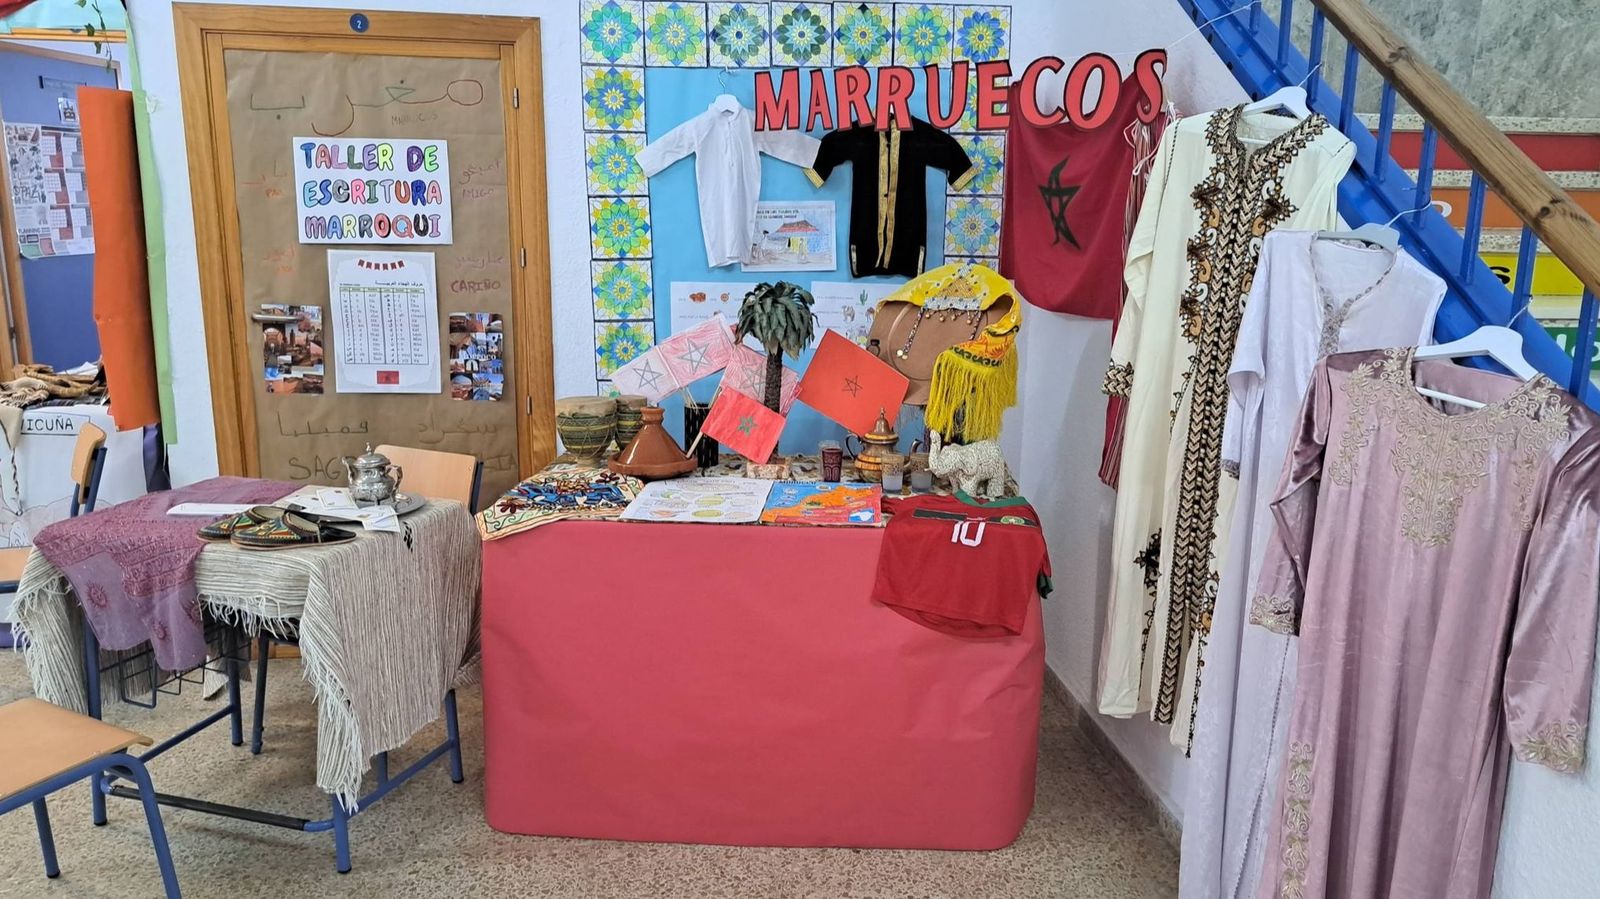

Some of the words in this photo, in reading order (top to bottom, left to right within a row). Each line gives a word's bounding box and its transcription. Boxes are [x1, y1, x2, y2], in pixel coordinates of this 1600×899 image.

[754, 48, 1168, 132] MARRUECOS
[300, 142, 394, 171] TALLER
[406, 144, 440, 172] DE
[303, 178, 443, 208] ESCRITURA
[304, 212, 442, 239] MARROQUI
[951, 520, 986, 547] 10
